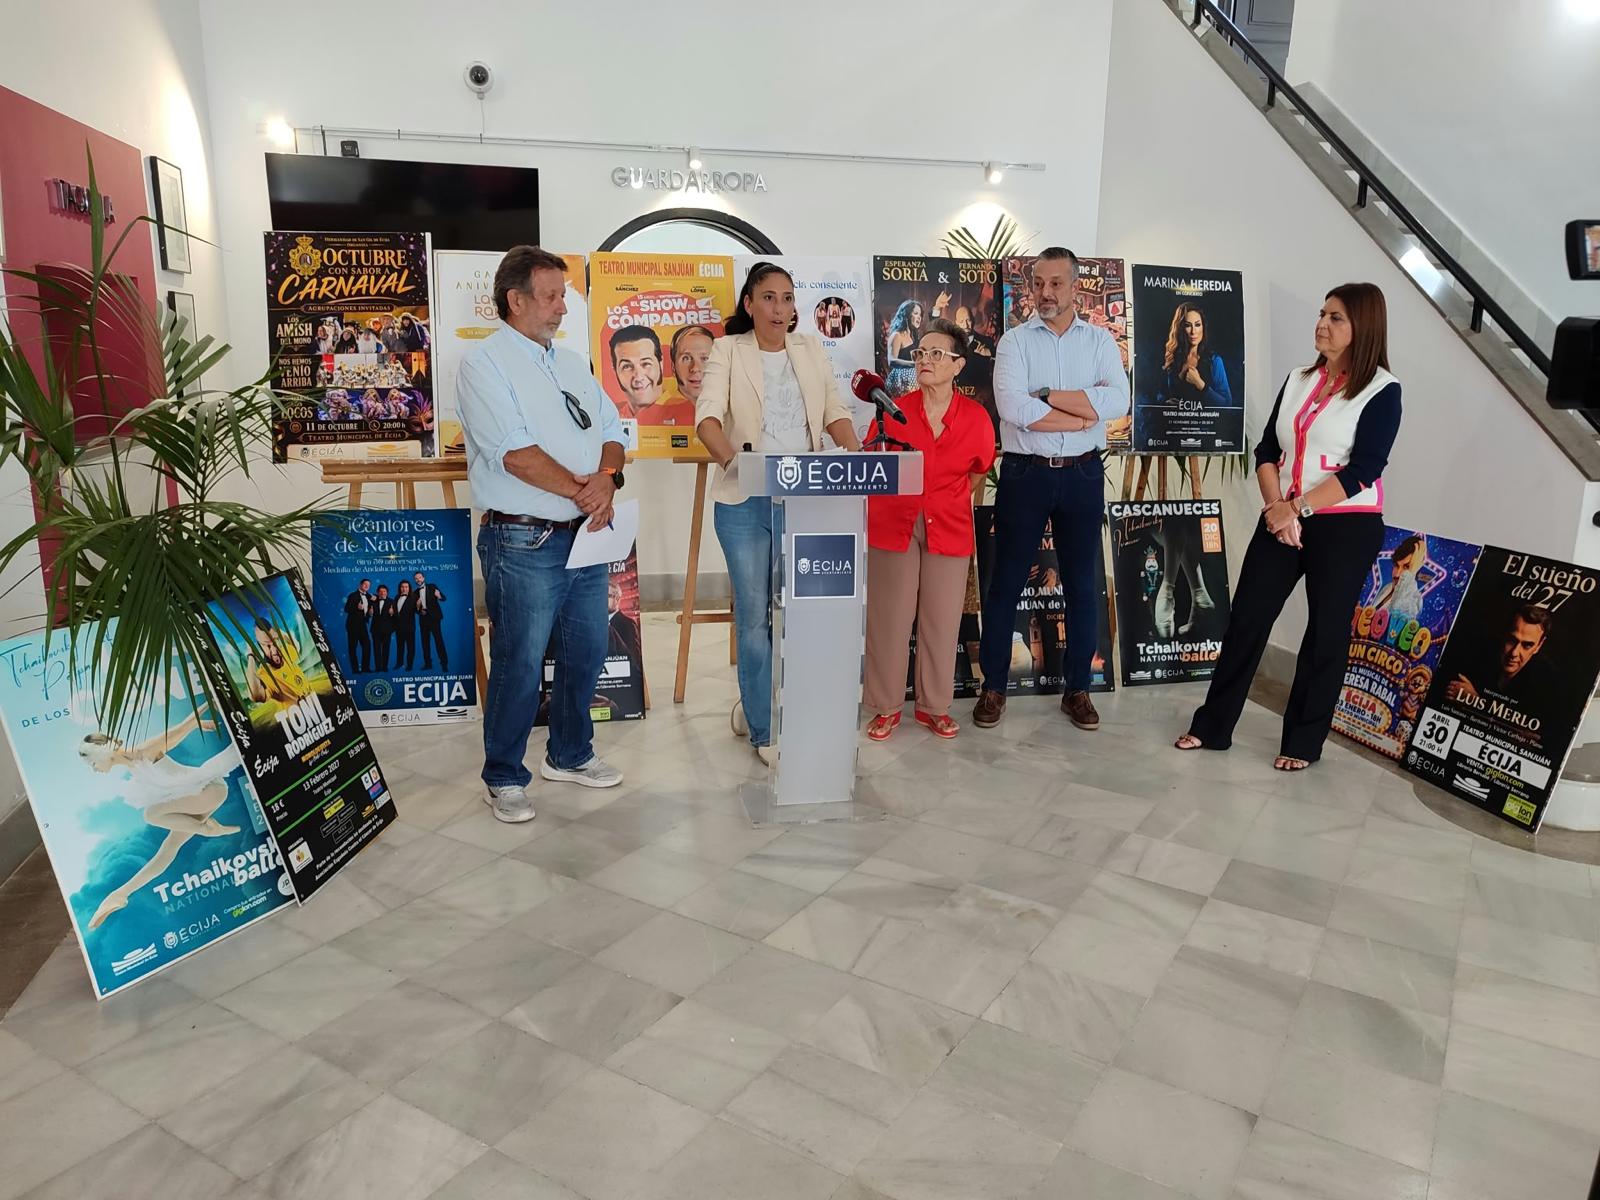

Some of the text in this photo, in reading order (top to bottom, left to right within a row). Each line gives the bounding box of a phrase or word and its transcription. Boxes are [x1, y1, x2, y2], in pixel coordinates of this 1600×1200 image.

[611, 166, 767, 193] GUARDARROPA
[323, 248, 407, 269] OCTUBRE
[599, 261, 625, 274] TEATRO
[626, 261, 662, 276] MUNICIPAL
[699, 261, 725, 278] ÉCIJA
[882, 267, 929, 282] SORIA
[938, 271, 950, 284] &
[959, 270, 997, 284] SOTO
[1091, 265, 1100, 276] al
[278, 268, 416, 305] CARNAVAL
[810, 280, 858, 290] consciente
[1144, 276, 1233, 292] MARINA HEREDIA
[607, 305, 630, 315] LOS
[640, 298, 688, 311] SHOW
[607, 309, 722, 329] COMPADRES
[276, 323, 313, 337] AMISH
[294, 336, 312, 344] MONO
[281, 377, 313, 388] ARRIBA
[1178, 399, 1203, 410] ÉCIJA
[306, 422, 358, 431] 11 DE OCTUBRE
[308, 434, 334, 442] TEATRO
[808, 459, 888, 483] ÉCIJA
[1111, 502, 1220, 517] CASCANUECES
[1204, 523, 1218, 533] 20
[335, 535, 444, 553] de Navidad!
[812, 559, 852, 572] ÉCIJA
[1502, 554, 1597, 594] El sueño
[1048, 600, 1061, 609] de
[1511, 580, 1574, 613] del 27
[1137, 639, 1223, 655] Tchaikovsky
[1348, 643, 1403, 675] UN CIRCO
[1358, 666, 1381, 683] MUSICAL
[1381, 678, 1389, 687] DE
[404, 681, 468, 706] ECIJA
[1370, 681, 1397, 707] RABAL
[22, 707, 71, 728] DE LOS
[1345, 702, 1366, 716] ENERO
[1456, 687, 1541, 732] LUIS MERLO
[1431, 713, 1451, 726] ABRIL
[284, 717, 336, 760] RODRÍGUEZ
[1422, 721, 1449, 745] 30
[1419, 738, 1443, 754] 21:00 H
[1463, 724, 1551, 767] TEATRO MUNICIPAL SANJUÁN
[254, 754, 280, 778] Écija
[1466, 757, 1485, 771] VENTA:
[1477, 743, 1522, 777] ÉCIJA
[302, 759, 340, 791] 13 Febrero 2027
[271, 802, 280, 813] 18
